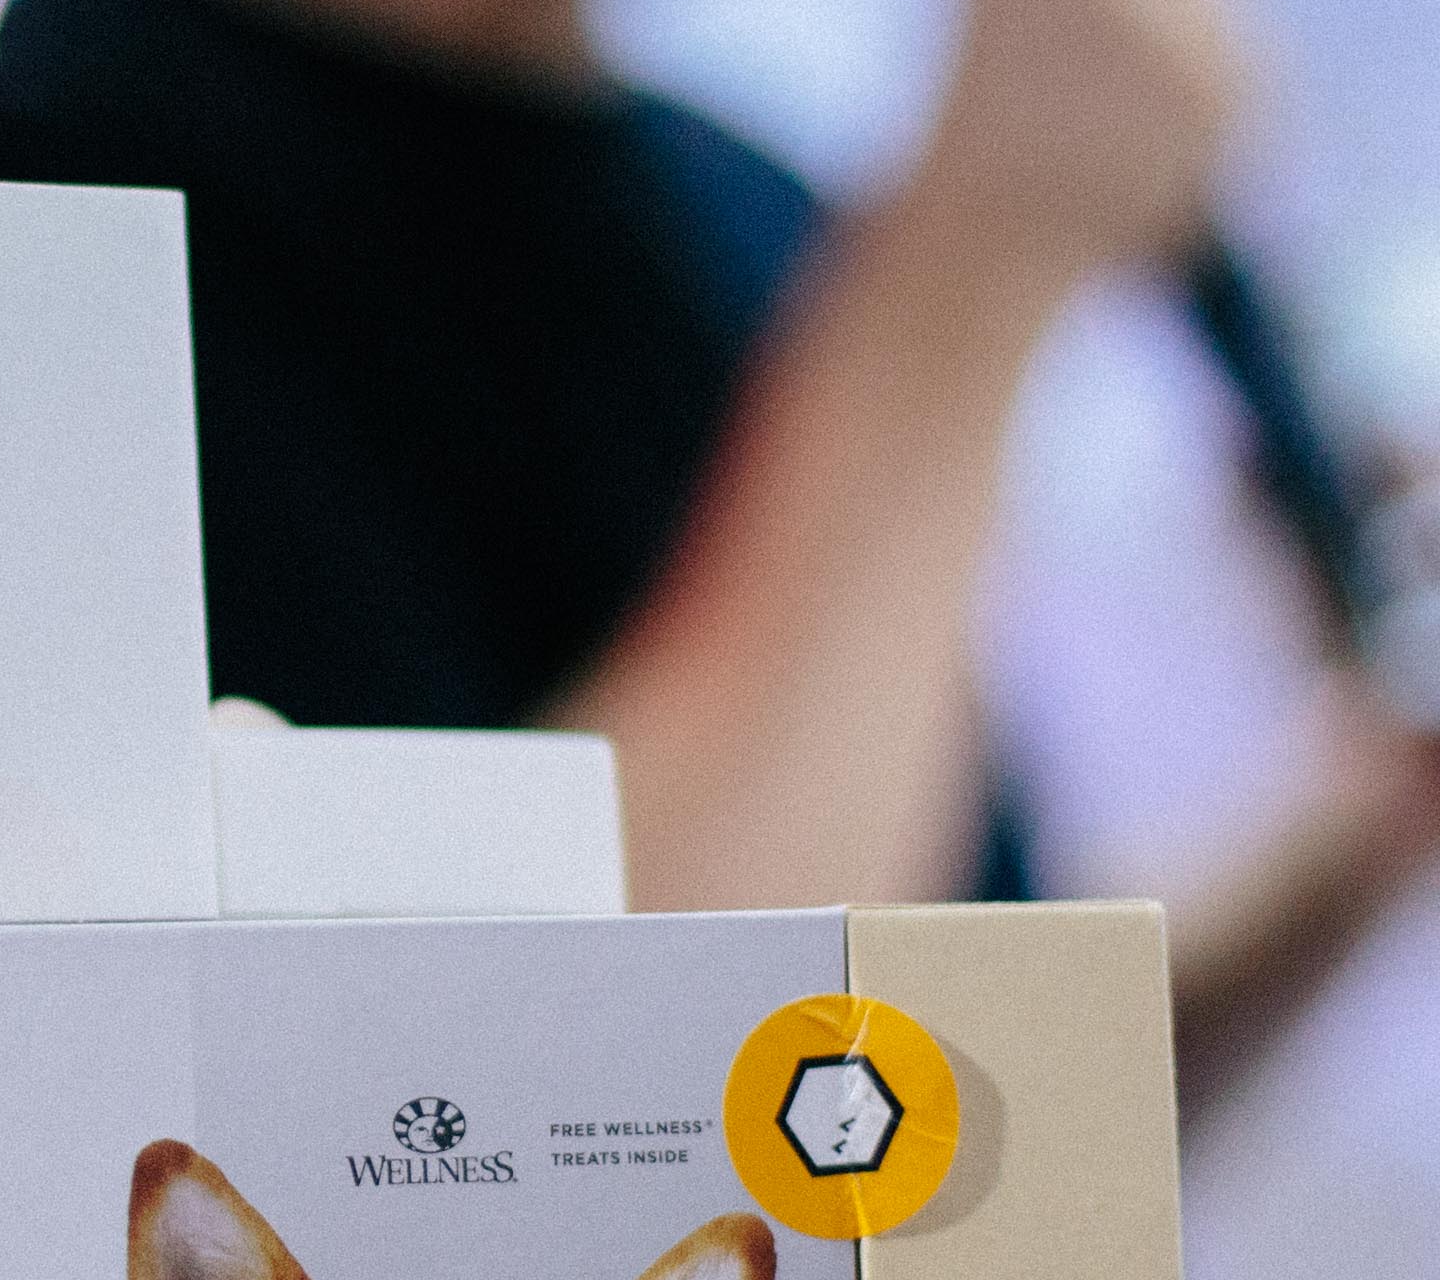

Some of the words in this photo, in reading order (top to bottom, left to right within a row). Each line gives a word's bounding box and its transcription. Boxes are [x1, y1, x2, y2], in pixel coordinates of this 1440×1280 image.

[550, 1122, 597, 1138] FREE
[551, 1151, 621, 1166] TREATS
[627, 1149, 689, 1164] INSIDE
[346, 1149, 515, 1187] WELLNESS
